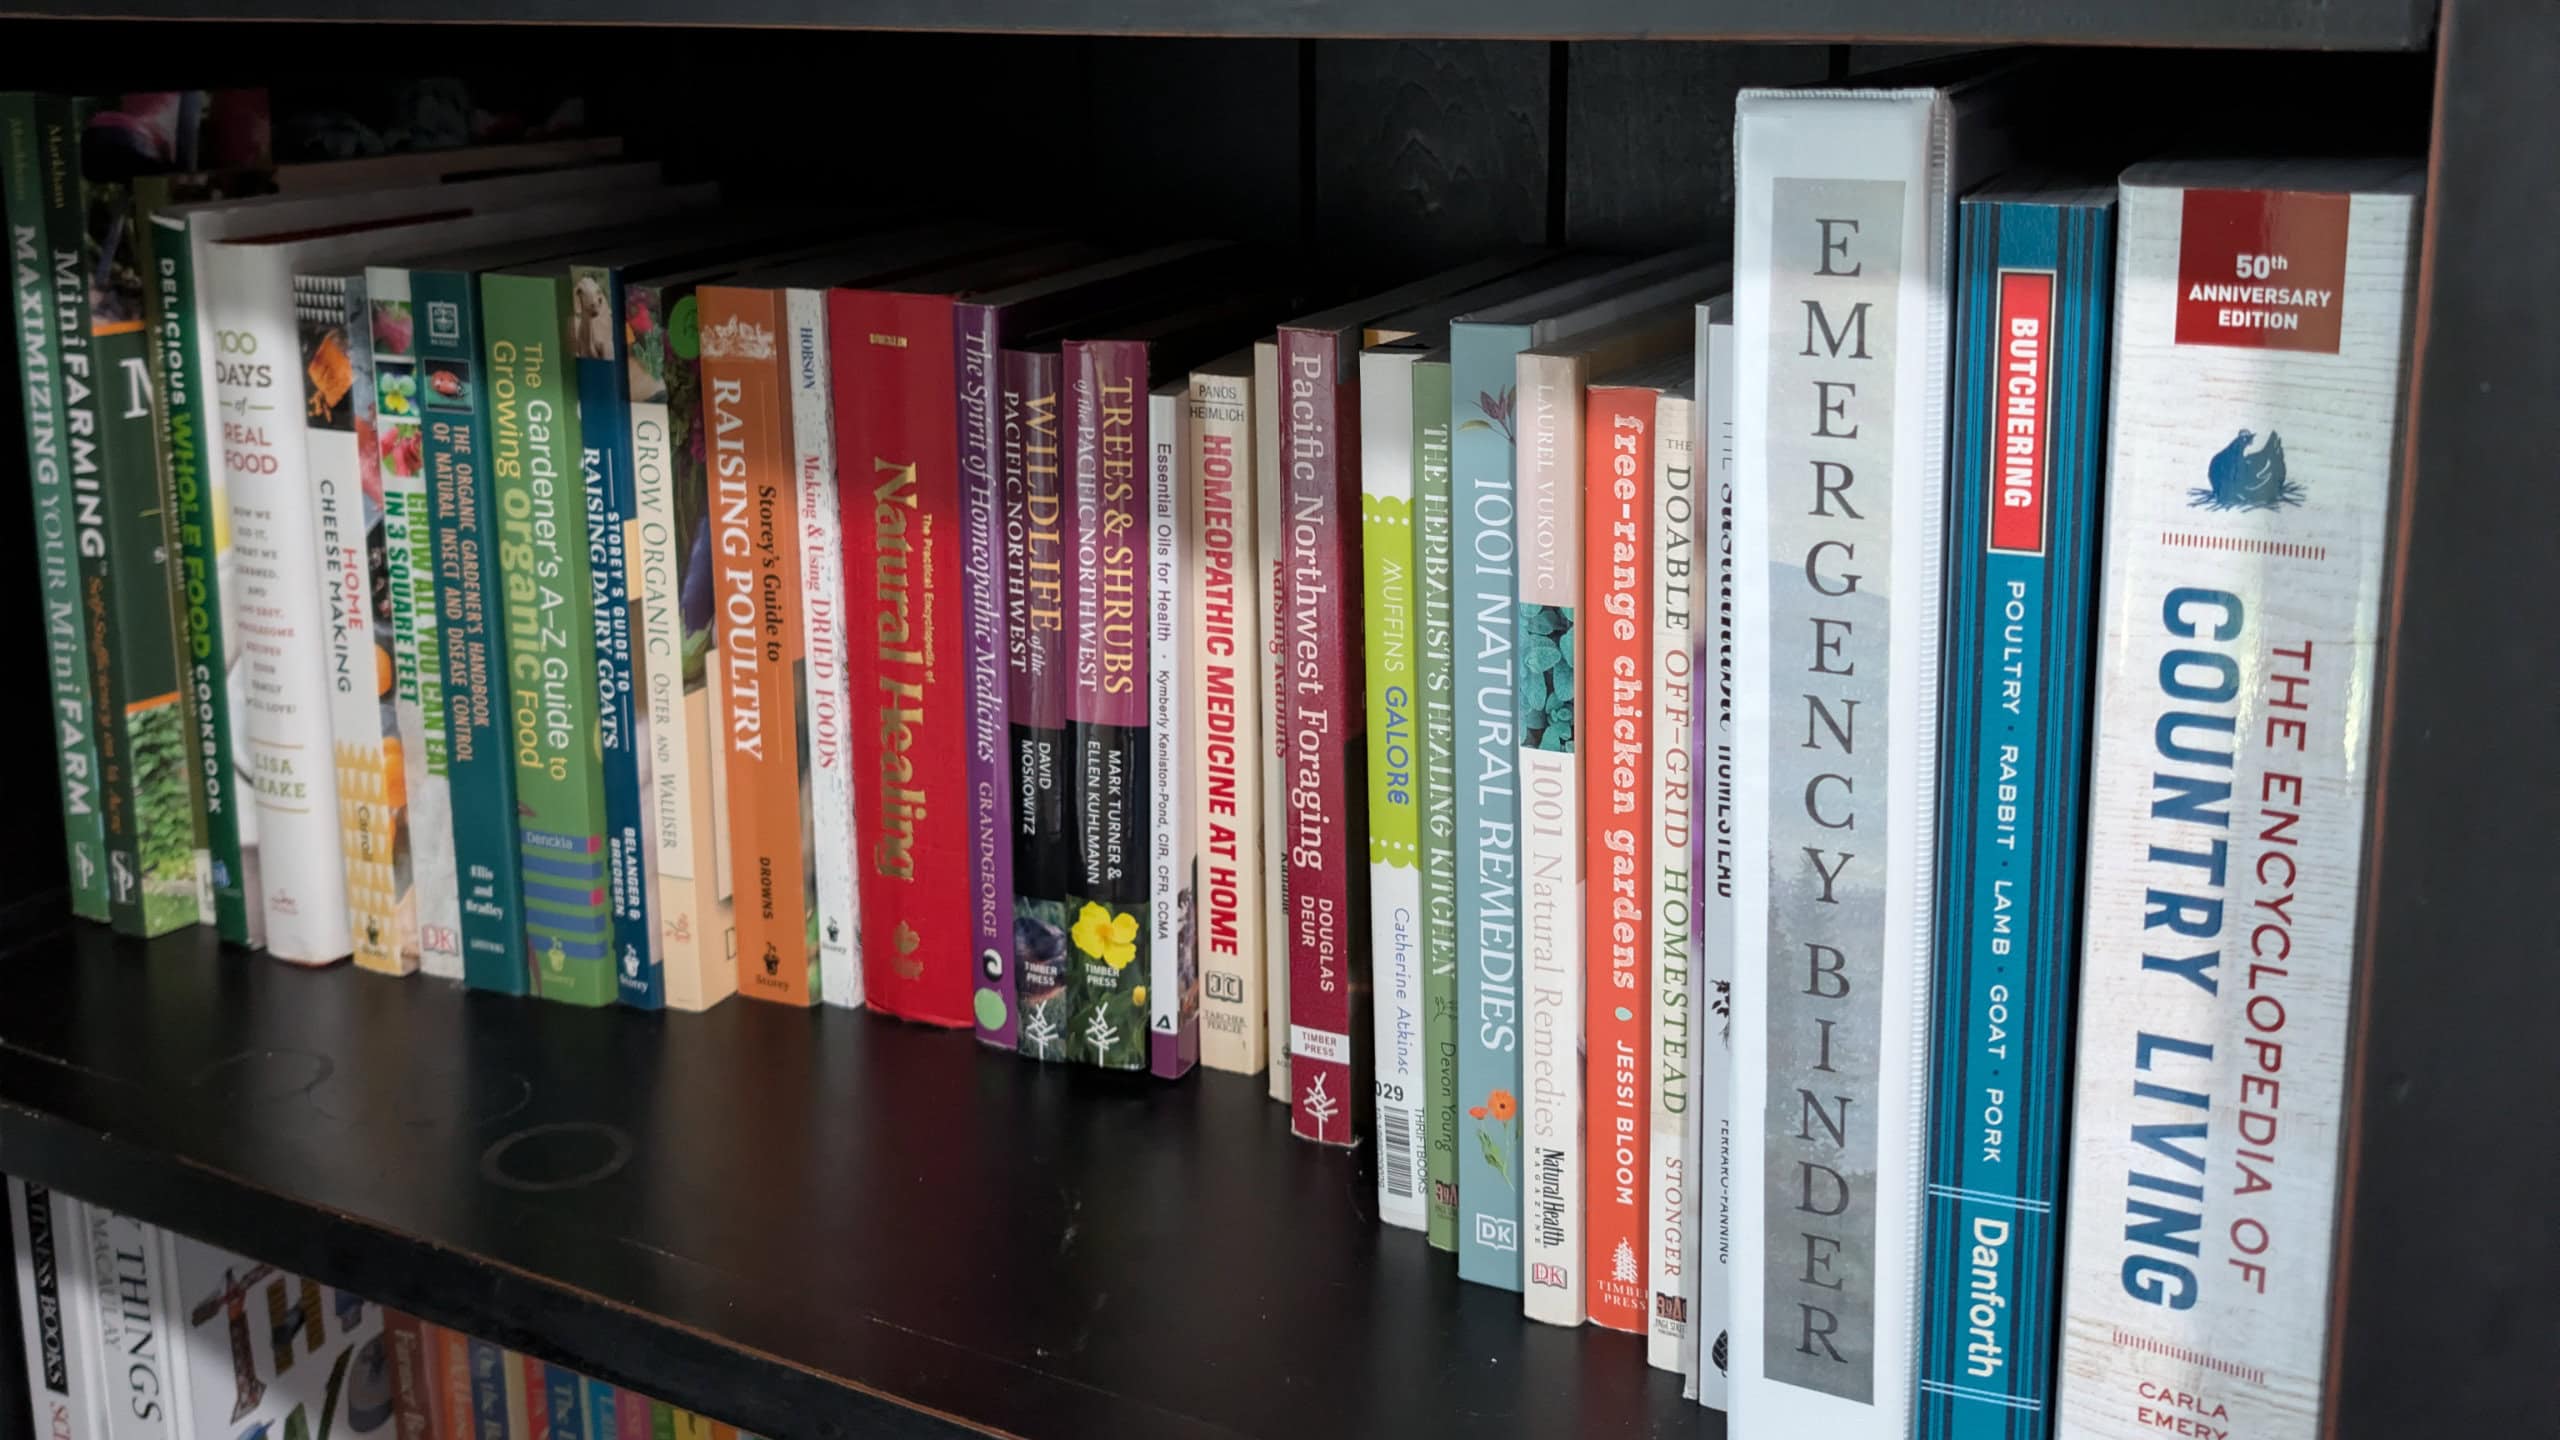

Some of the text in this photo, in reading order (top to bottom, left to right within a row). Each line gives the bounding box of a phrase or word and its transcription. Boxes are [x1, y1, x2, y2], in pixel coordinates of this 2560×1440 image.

[160, 258, 187, 405] DELICIOUS
[2189, 283, 2332, 308] ANNIVERSARY
[2218, 309, 2298, 330] EDITION
[2235, 254, 2288, 279] 50th
[54, 249, 105, 557] Mini FARMING
[216, 330, 257, 356] 100
[216, 365, 273, 389] DAYS
[800, 327, 816, 390] HOBSON
[1198, 384, 1238, 400] PANOS
[224, 423, 272, 449] REAL
[225, 453, 278, 476] FOOD
[1189, 405, 1245, 423] HEIMLICH
[1666, 437, 1693, 451] THE
[2004, 317, 2038, 507] BUTCHERING
[14, 225, 92, 816] MAXIMIZING YOUR Mini FARM
[170, 413, 203, 546] WHOLE
[1004, 391, 1027, 673] PACIFIC NORTHWEST
[1025, 392, 1063, 632] WILDLIFE
[1103, 377, 1134, 694] TREES SHRUBS
[1537, 384, 1554, 590] LAUREL VUKOVIC
[185, 556, 211, 658] FOOD
[320, 479, 352, 693] CHEESE MAKING
[342, 548, 364, 630] HOME
[387, 521, 415, 647] 3 SQUARE
[432, 422, 473, 763] OF NATURAL INSECT AND DISEASE CONTROL
[453, 424, 490, 728] THE ORGANIC HANDBOOK
[494, 340, 544, 769] Growing Food
[584, 447, 620, 750] RAISING DAIRY GOATS
[607, 511, 629, 661] STOREY'S GUIDE
[713, 378, 763, 762] RAISING POULTRY
[757, 484, 784, 636] Storey's Guide
[803, 455, 838, 769] Making & Using DRIED FOODS
[922, 538, 936, 668] Practical Encyclopedia
[1291, 352, 1330, 872] Pacific Northwest Foraging
[1382, 557, 1405, 673] MUFFINS
[636, 419, 677, 850] GROW ORGANIC OSTER AND WALLISER
[874, 456, 927, 883] Natural Healing
[1155, 442, 1172, 941] Essential Oils for Health Kymberly Keniston-Pond, CFR, CCMA
[1203, 433, 1239, 957] HOMEOPATHIC MEDICINE AT HOME
[196, 665, 222, 814] COOKBOOK
[254, 753, 293, 775] LISA
[543, 657, 574, 782] Guide to
[1038, 741, 1051, 790] DAVID
[1474, 478, 1516, 1053] 1001 NATURAL REMEDIES
[1603, 413, 1644, 990] free-range chicken gardens
[974, 647, 1003, 939] Medicines GRANDGEORGE
[1021, 739, 1036, 836] MOSKOWITZ
[1086, 741, 1101, 885] ELLEN KUHLMANN
[1107, 750, 1122, 881] MARK TURNER &
[1428, 701, 1456, 978] HEALING KITCHEN
[1663, 464, 1692, 1115] DOABLE OFF-GRID HOMESTEAD
[1795, 218, 1873, 1364] EMERGENCY BINDER
[610, 836, 625, 917] BREDESEN
[623, 826, 641, 908] BELANGER
[759, 856, 774, 921] DROWNS
[1300, 894, 1316, 948] DEUR
[1982, 580, 2026, 1163] POULTRY RABBIT LAMB GOAT PORK
[1024, 961, 1058, 976] TIMBER
[1026, 973, 1055, 986] PRESS
[1318, 898, 1335, 993] DOUGLAS
[1394, 907, 1413, 1000] Catherine
[1534, 855, 1567, 1137] Natural Remedies
[2121, 587, 2244, 1311] COUNTRY LIVING
[2228, 640, 2312, 1295] THE ENCYCLOPEDIA OF
[1414, 1106, 1428, 1195] THRIFTBOOKS
[1434, 1041, 1457, 1153] Devon Young
[1615, 1040, 1634, 1206] JESSI BLOOM
[1481, 1224, 1511, 1244] DK
[1534, 1263, 1563, 1286] DK
[1664, 1155, 1683, 1277] STONGER
[40, 1295, 64, 1386] BOOKS
[92, 1218, 121, 1351] MACAULAY
[116, 1248, 163, 1423] THINGS
[1604, 1292, 1647, 1311] PRESS
[1967, 1216, 2010, 1379] Danforth
[2137, 1381, 2229, 1422] CARLA
